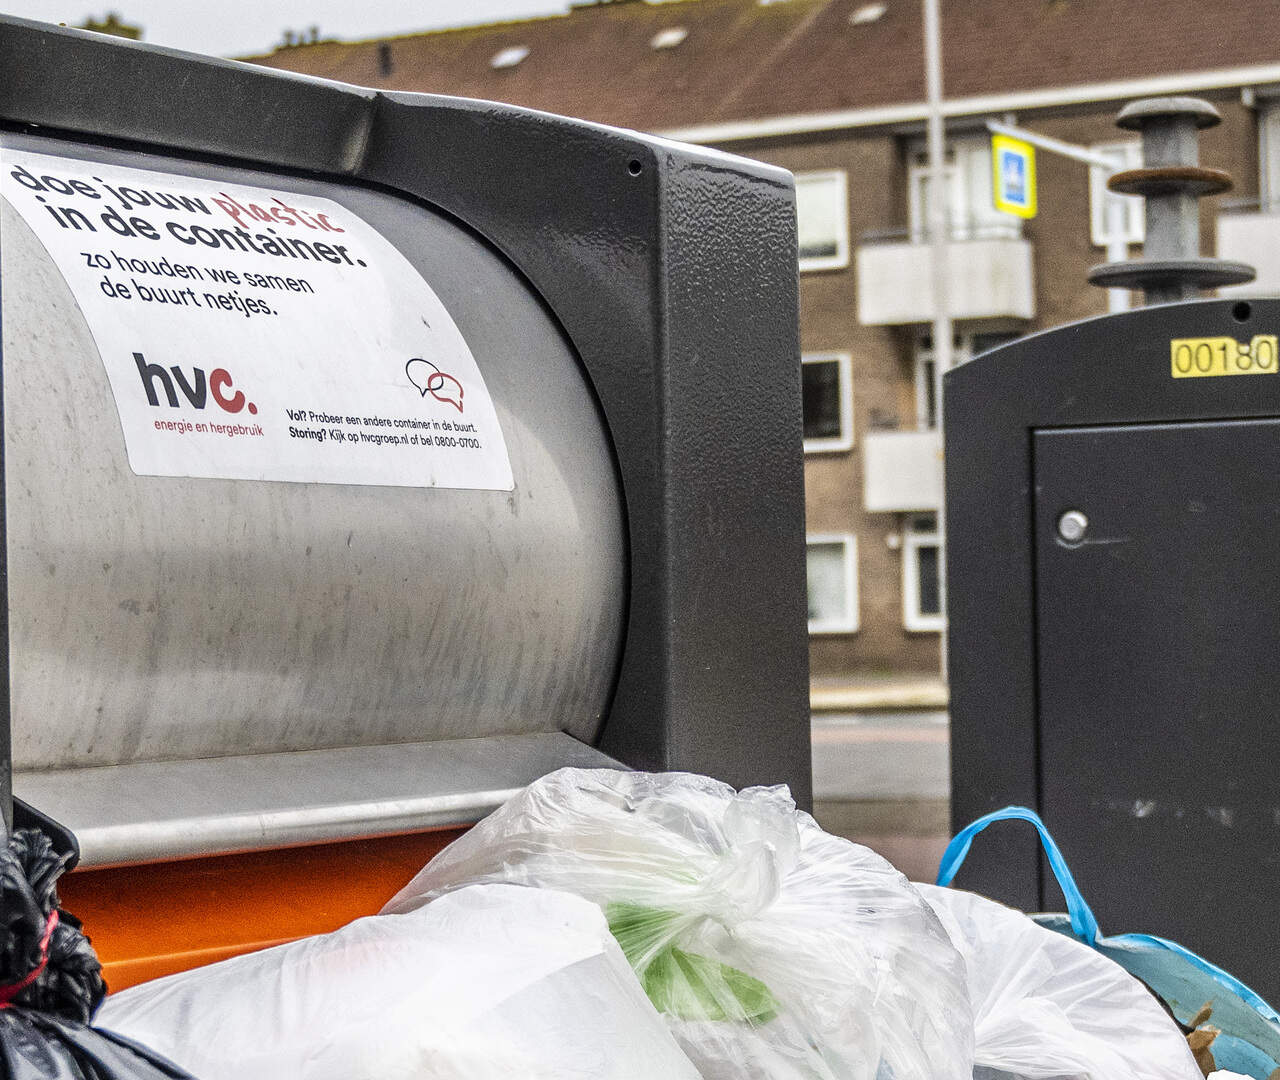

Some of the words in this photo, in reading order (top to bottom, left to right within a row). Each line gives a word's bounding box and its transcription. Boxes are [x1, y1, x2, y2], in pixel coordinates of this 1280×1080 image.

[10, 165, 101, 199] doe
[93, 176, 212, 215] jouw
[211, 192, 345, 233] plastic
[35, 195, 97, 232] in
[101, 205, 160, 241] de
[170, 221, 368, 268] container.
[80, 252, 111, 269] zo
[118, 250, 204, 281] houden
[205, 267, 239, 285] we
[247, 271, 315, 293] samen
[100, 275, 131, 300] de
[135, 279, 201, 308] buurt
[204, 290, 278, 318] netjes.
[1176, 341, 1273, 373] 00180
[132, 352, 258, 415] hvc.
[154, 419, 193, 434] energie
[195, 422, 209, 433] en
[210, 421, 265, 437] hergebruik
[286, 409, 307, 422] Vol?
[308, 411, 343, 425] Probeer
[345, 415, 362, 425] een
[363, 416, 392, 428] andere
[393, 418, 431, 430] container
[432, 419, 440, 430] in
[442, 420, 453, 431] de
[454, 421, 478, 433] buurt.
[289, 426, 327, 442] Storing?
[328, 430, 346, 443] Kijk
[348, 433, 359, 444] op
[360, 431, 409, 446] hvcgroep.nl
[410, 433, 419, 445] of
[421, 434, 433, 446] bel
[434, 435, 482, 449] 0800-0700.
